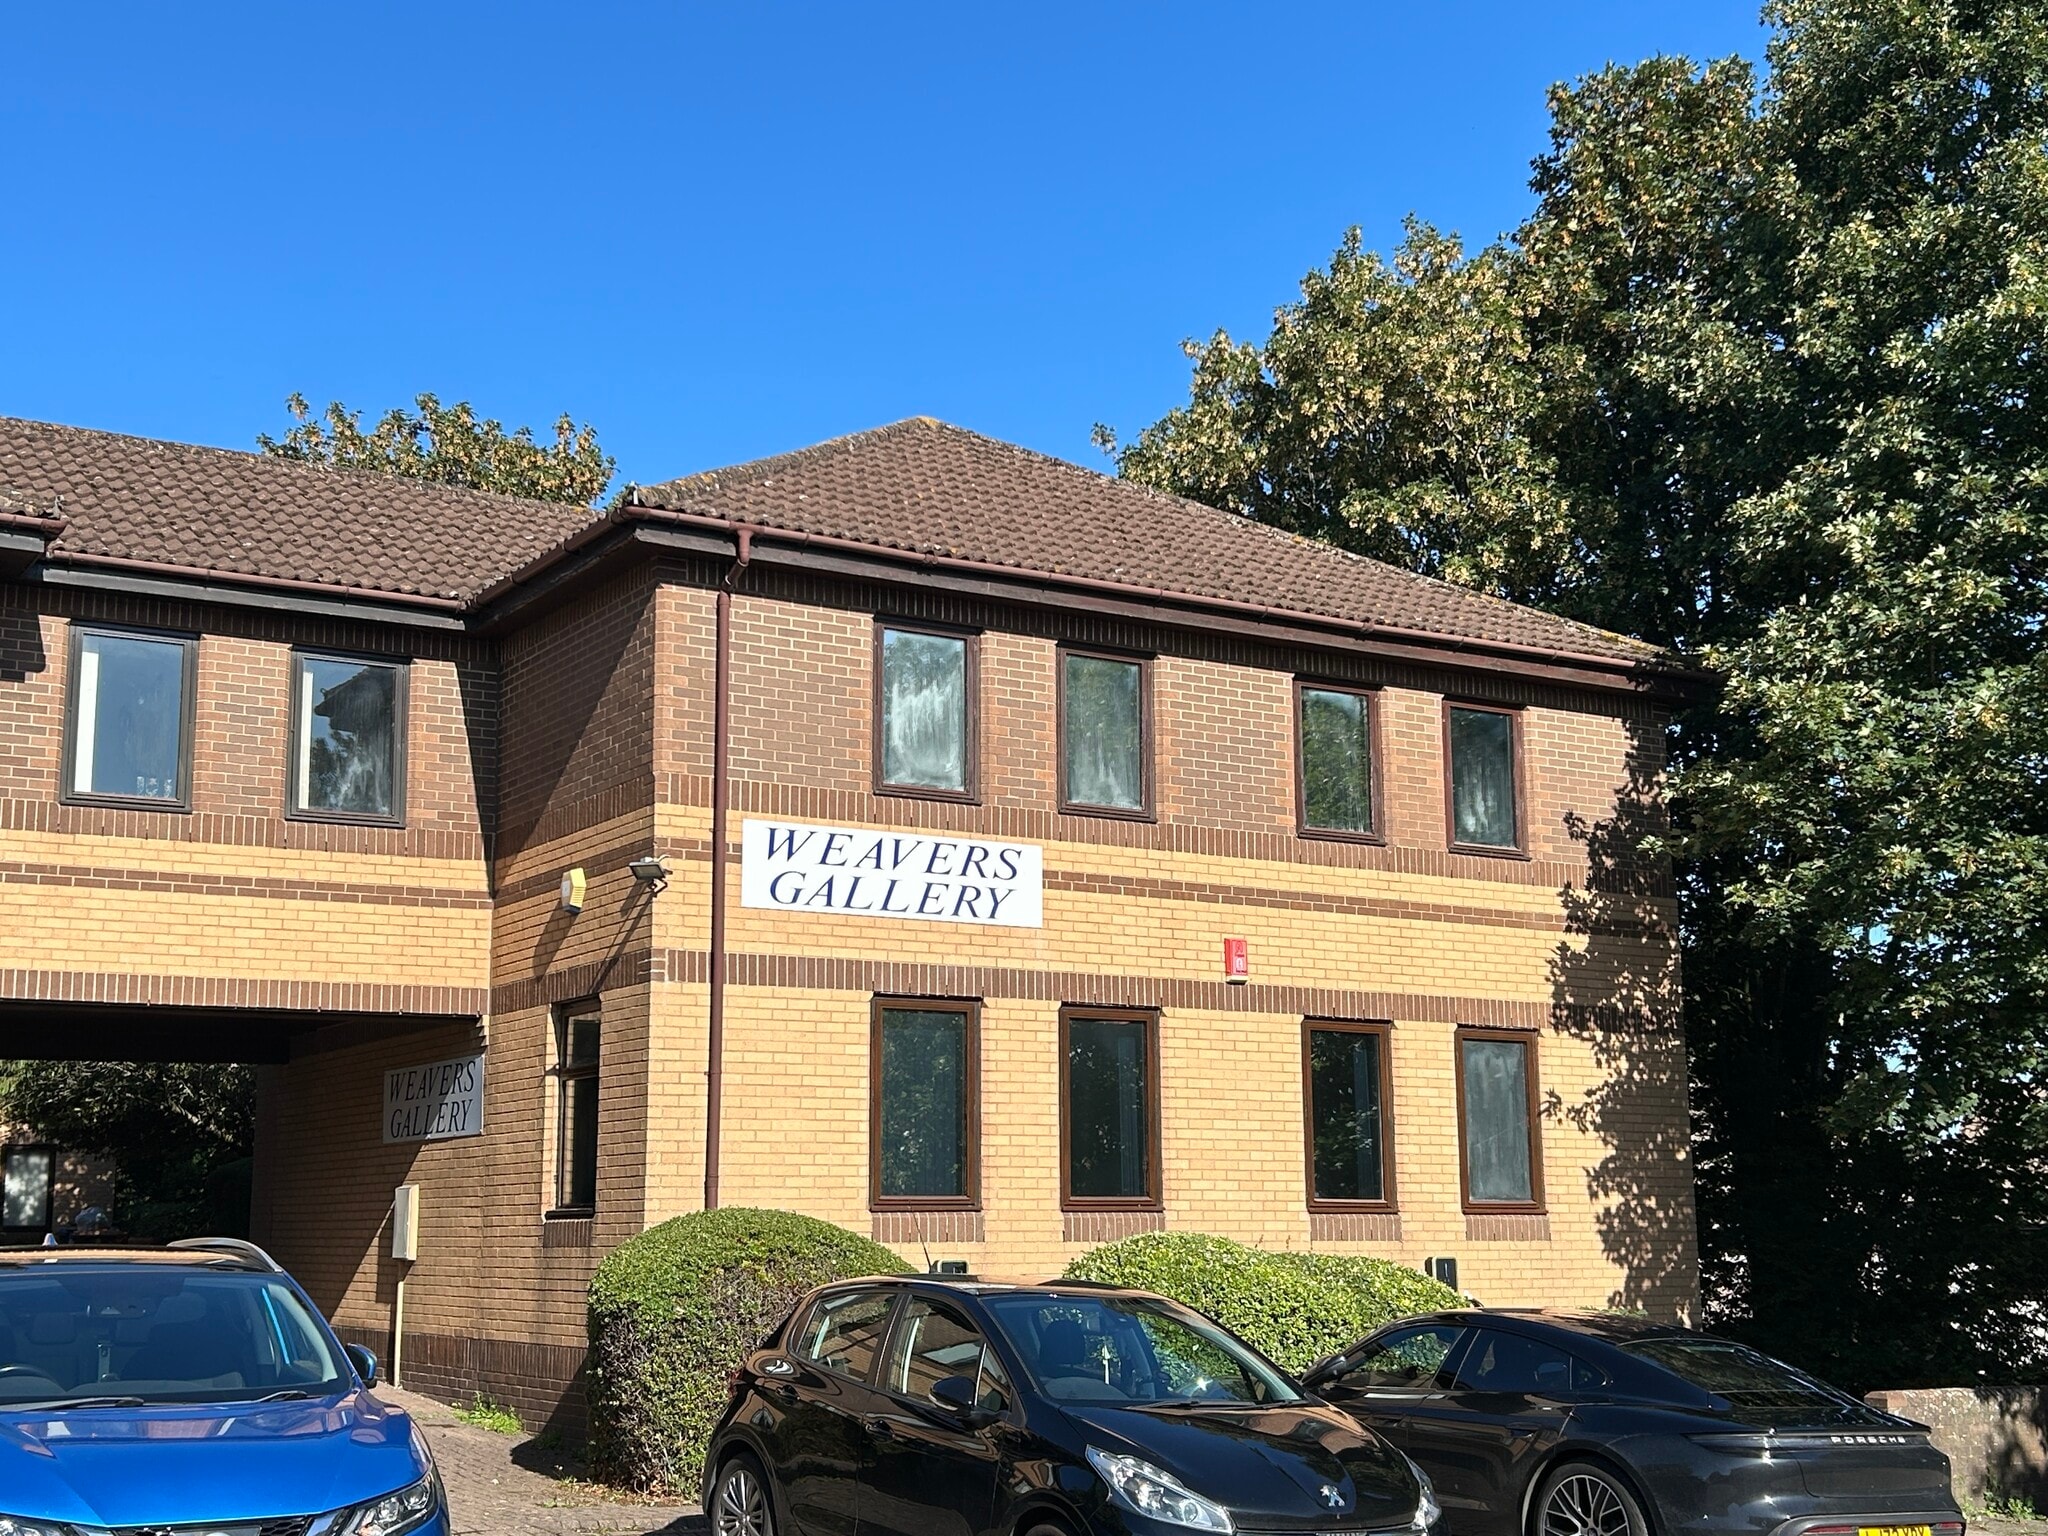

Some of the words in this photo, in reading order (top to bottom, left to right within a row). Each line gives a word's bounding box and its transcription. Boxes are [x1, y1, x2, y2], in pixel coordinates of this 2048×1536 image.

[767, 827, 1022, 881] WEAVERS
[769, 870, 1017, 920] GALLERY
[389, 1061, 476, 1102] WEAVERS
[390, 1099, 473, 1138] GALLERY
[1830, 1436, 1906, 1444] PORSCHE
